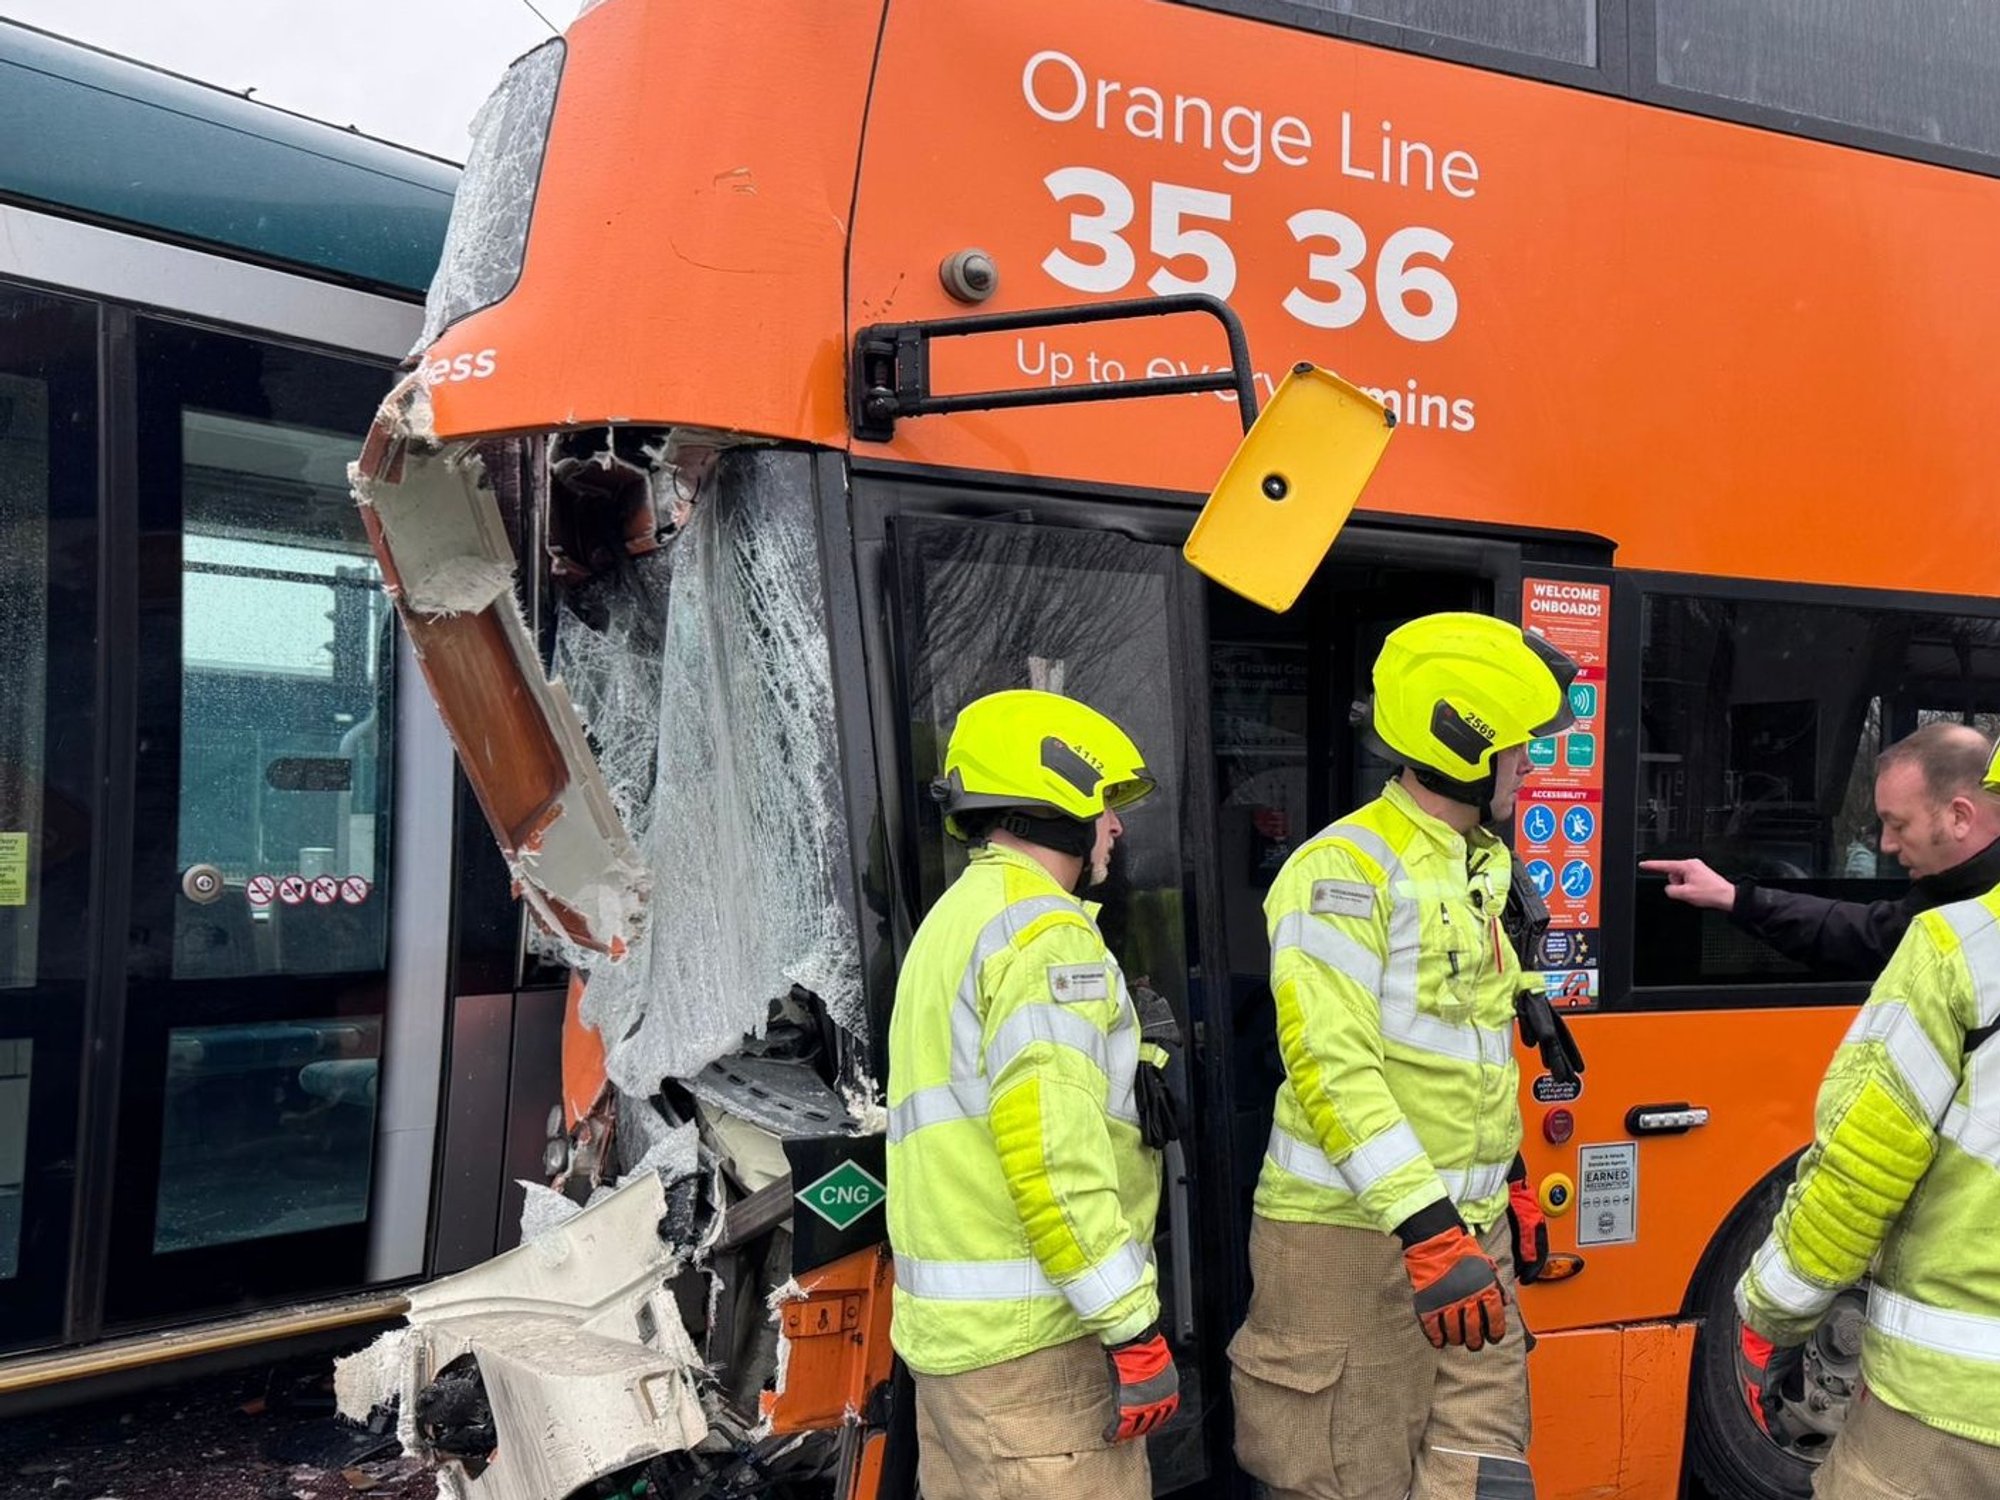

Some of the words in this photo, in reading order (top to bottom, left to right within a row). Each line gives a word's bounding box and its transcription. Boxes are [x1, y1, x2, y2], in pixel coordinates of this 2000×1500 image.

[1022, 49, 1312, 175] Orange
[1340, 111, 1480, 199] Line
[1041, 165, 1237, 303] 35
[1281, 208, 1458, 342] 36
[1015, 337, 1074, 387] Up
[1086, 349, 1126, 385] to
[1533, 583, 1601, 601] WELCOME
[1530, 599, 1602, 617] ONBOARD!
[1465, 711, 1496, 740] 2569
[1074, 744, 1105, 771] 4112
[1531, 790, 1588, 800] ACCESSIBILITY
[1586, 1170, 1629, 1183] EARNED
[820, 1184, 870, 1206] CNG
